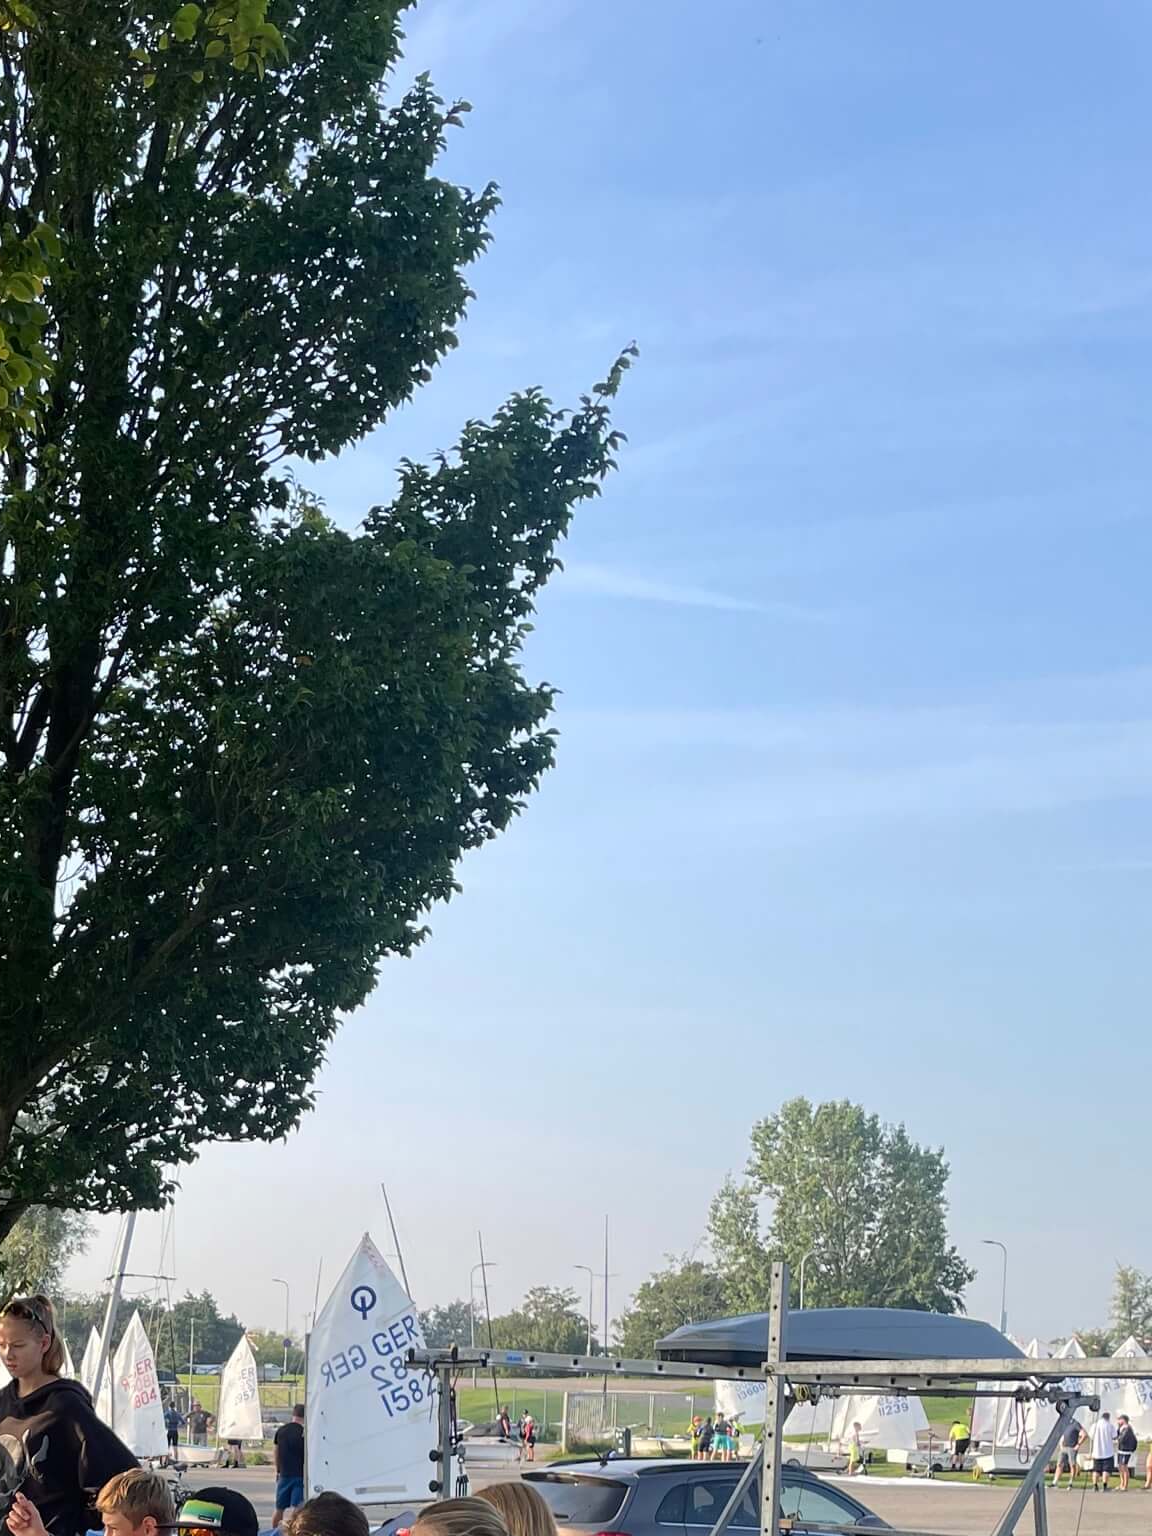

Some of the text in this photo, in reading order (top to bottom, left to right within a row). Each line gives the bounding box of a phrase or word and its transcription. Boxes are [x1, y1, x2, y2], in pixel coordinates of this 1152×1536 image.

[371, 1315, 419, 1356] GER
[135, 1358, 153, 1375] ER
[133, 1387, 157, 1409] 804
